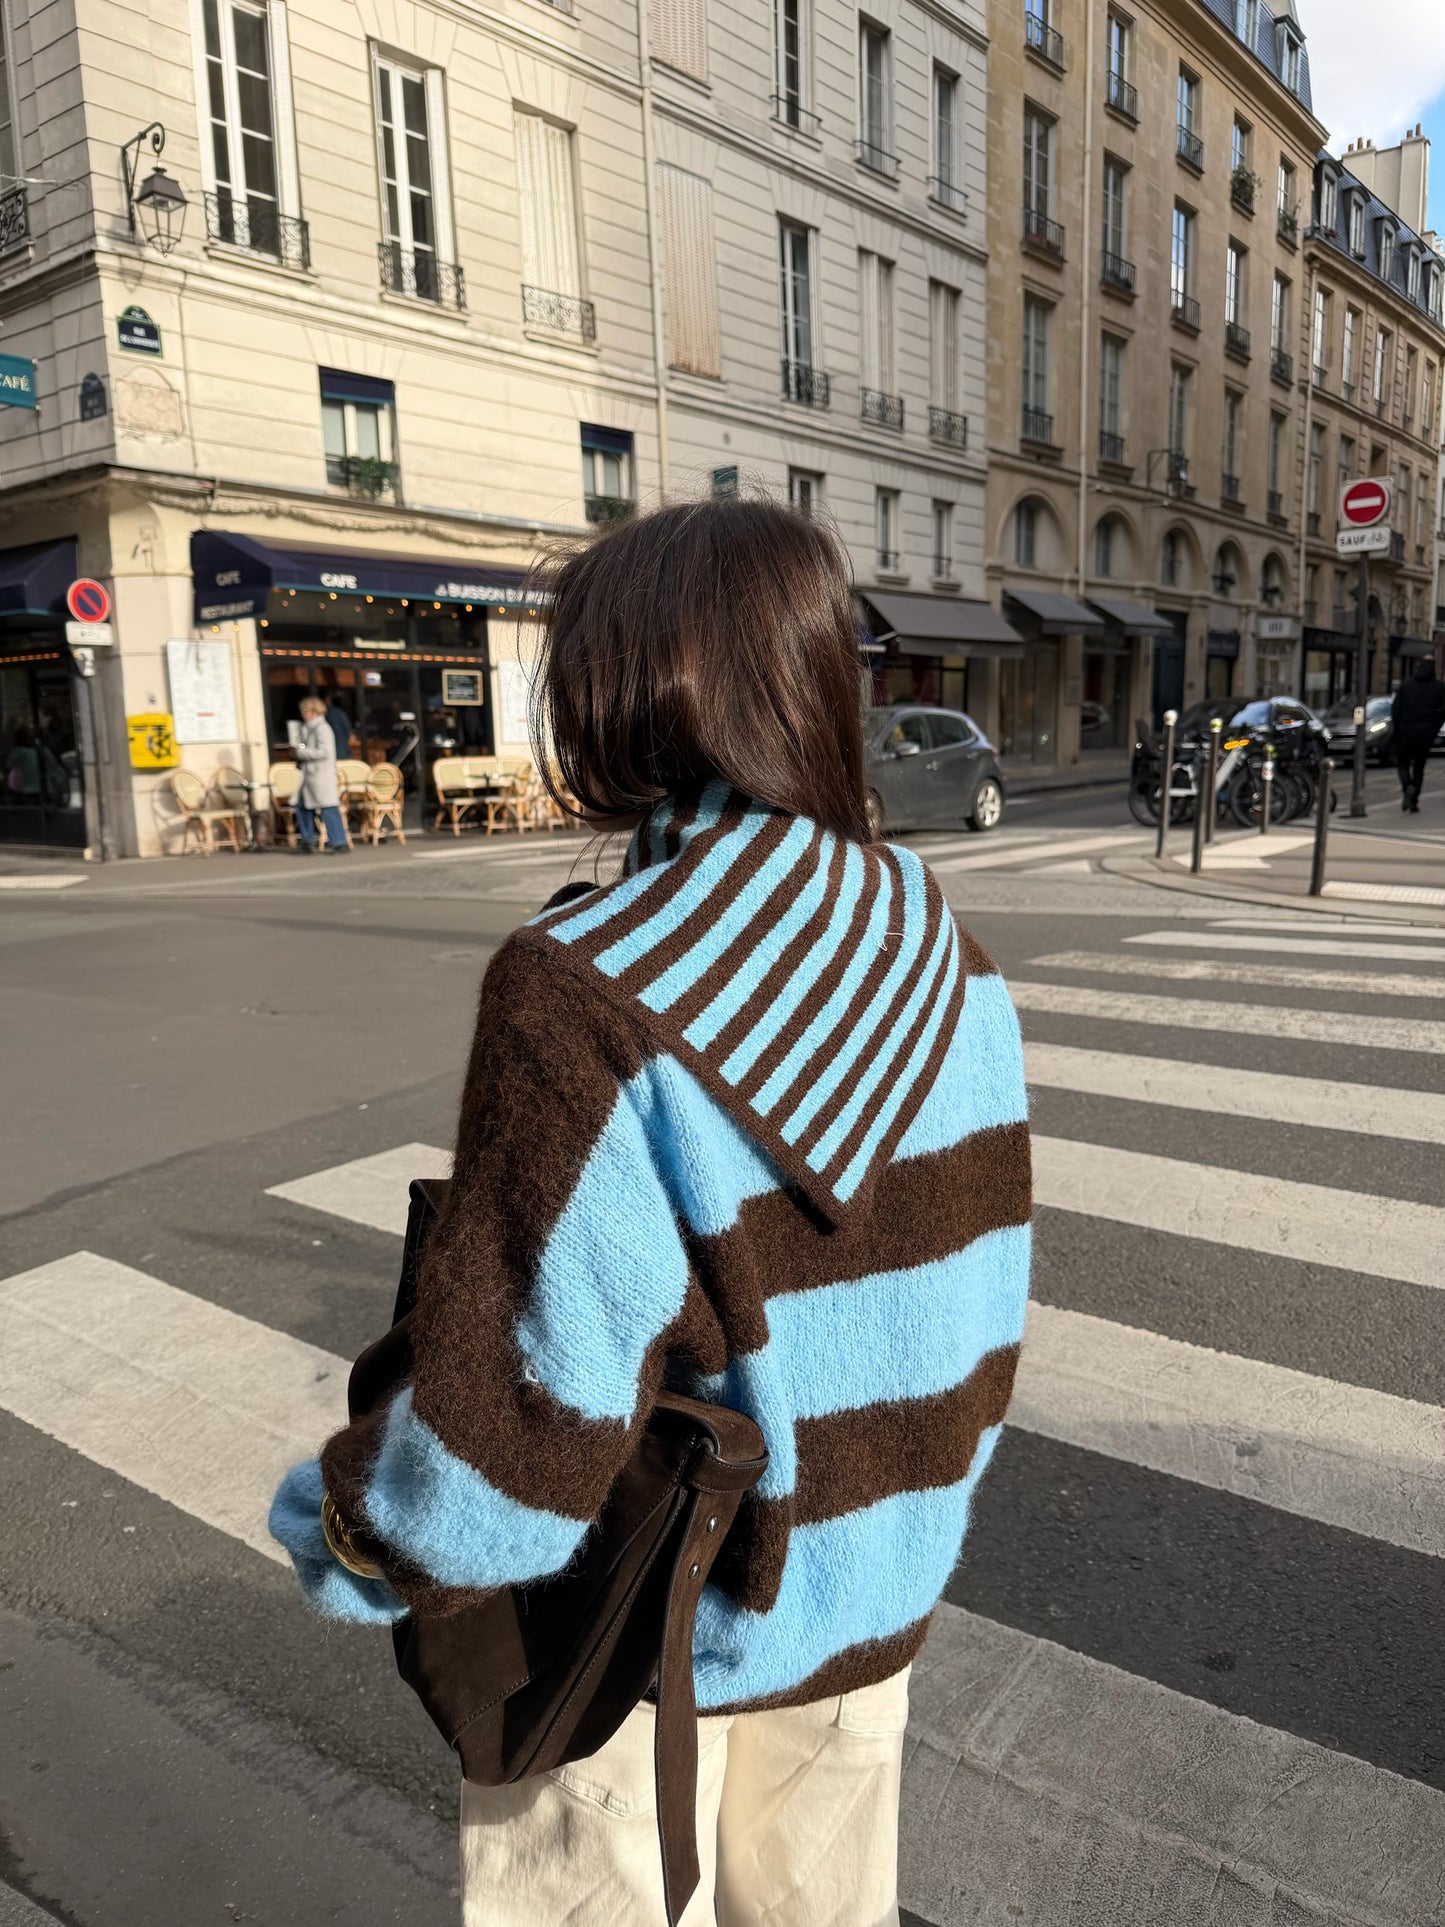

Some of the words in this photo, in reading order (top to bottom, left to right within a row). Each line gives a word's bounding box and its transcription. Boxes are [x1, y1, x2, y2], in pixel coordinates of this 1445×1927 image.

[1340, 535, 1366, 547] SAUF
[447, 582, 505, 602] BUISSON
[200, 600, 255, 620] RESTAURANT
